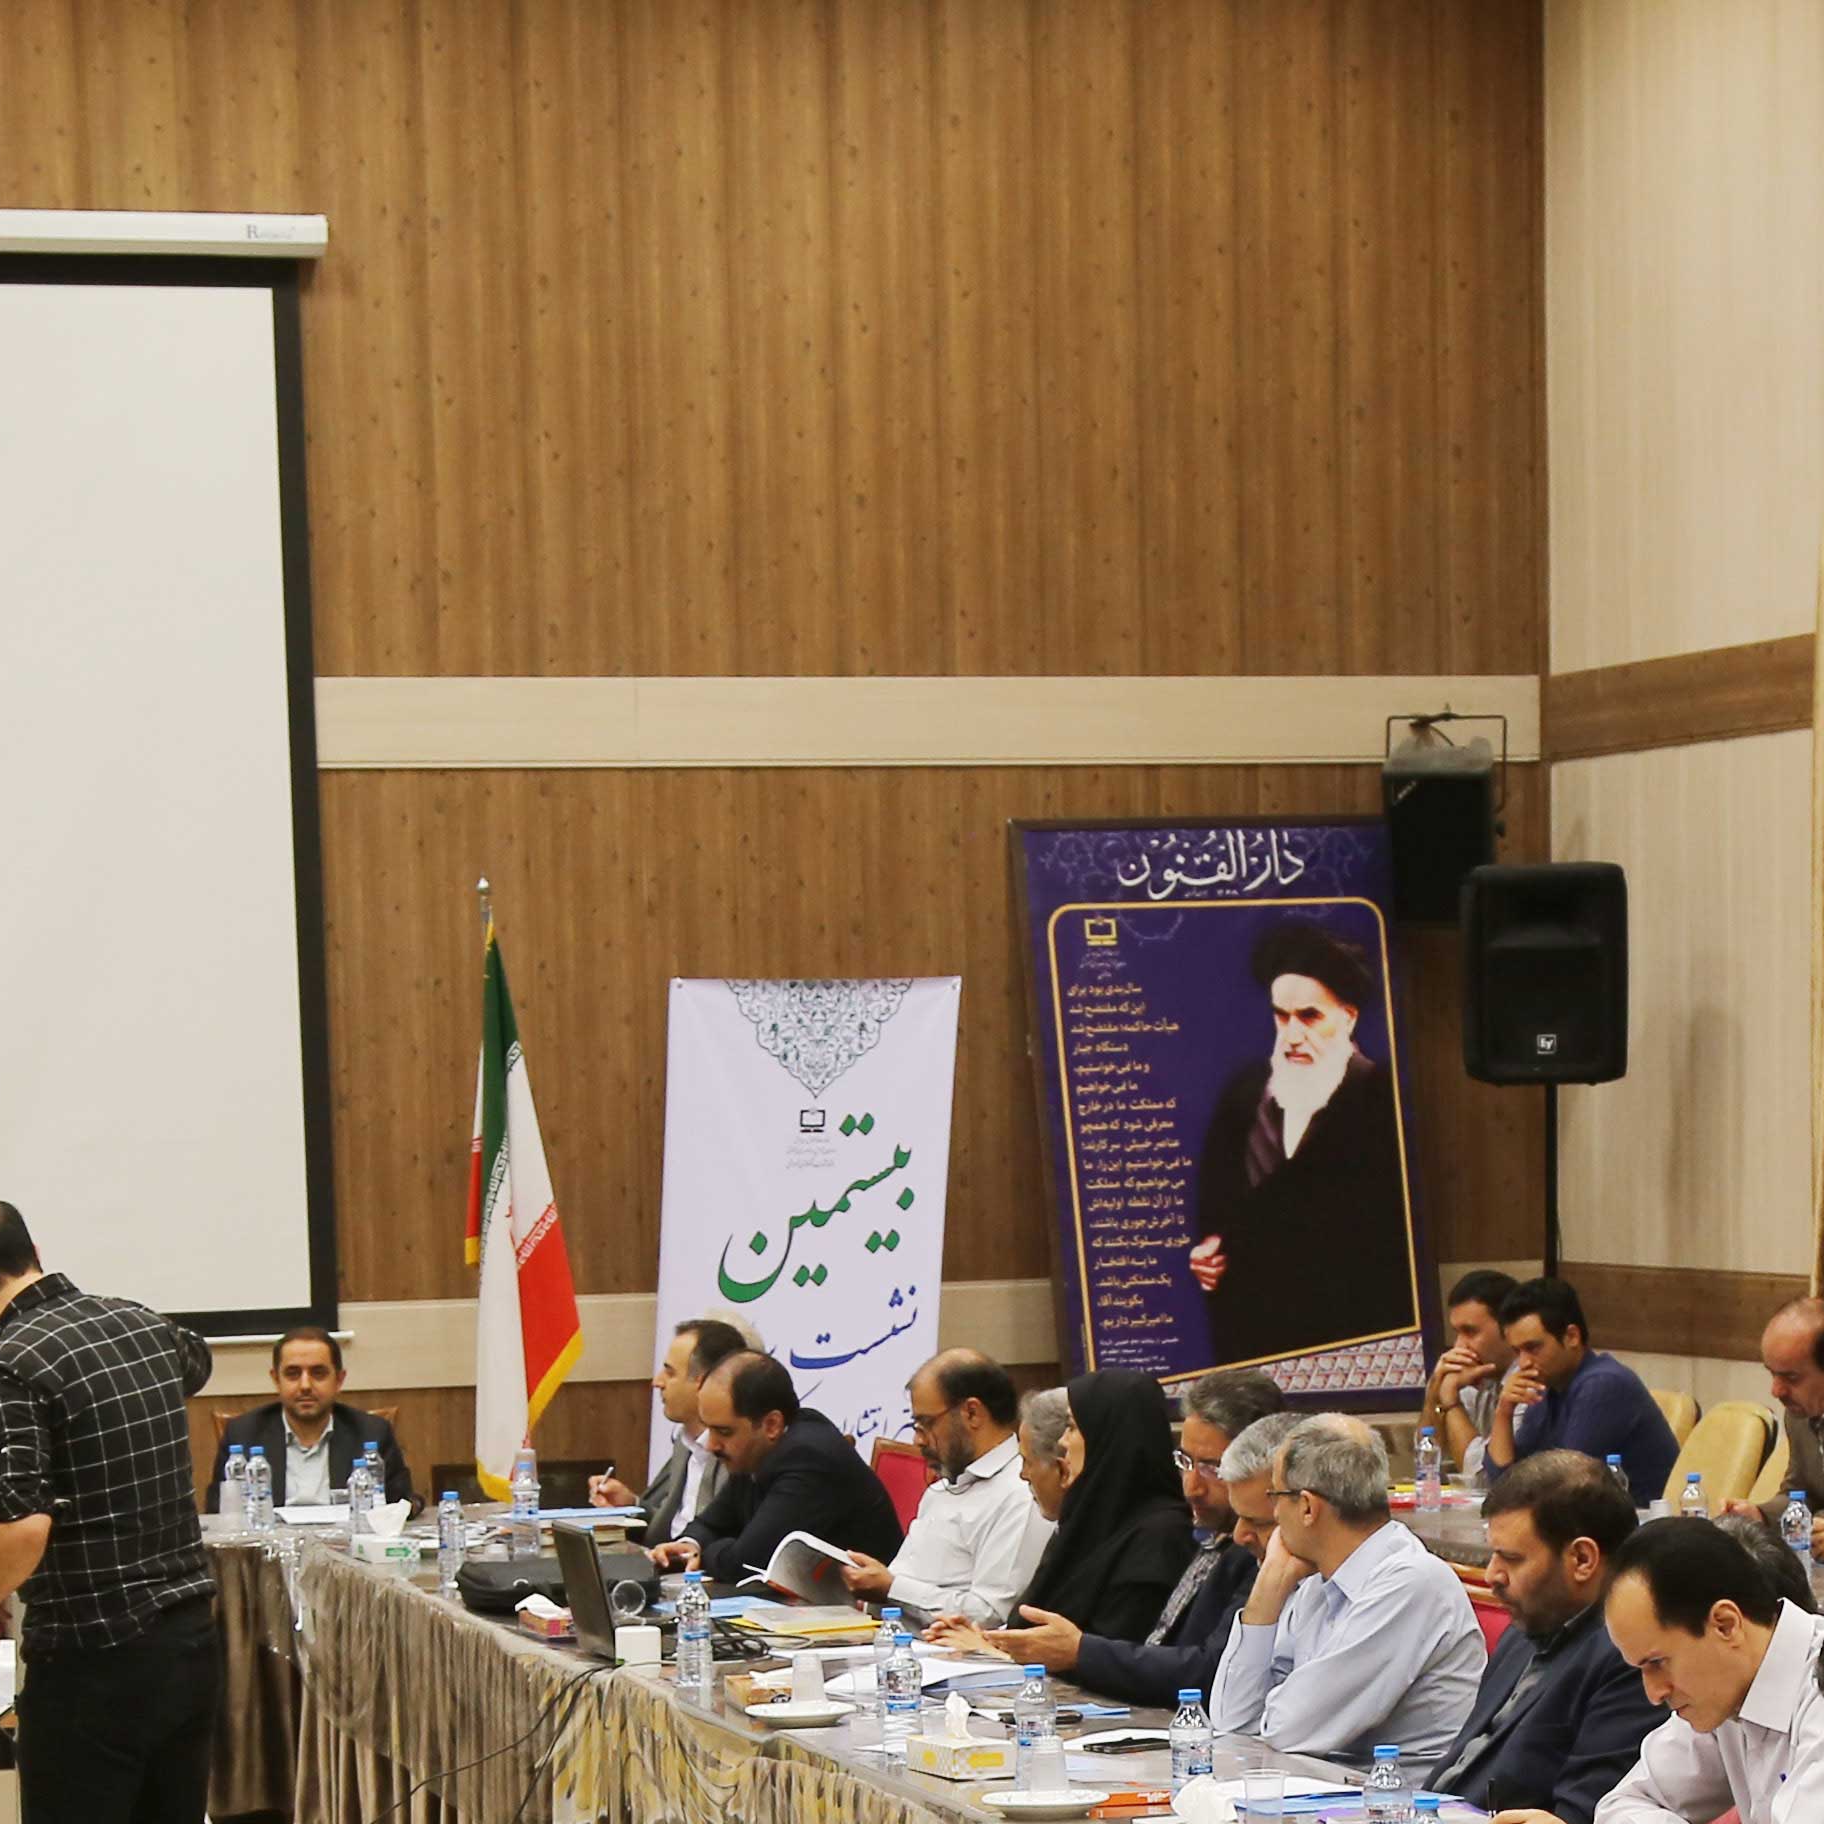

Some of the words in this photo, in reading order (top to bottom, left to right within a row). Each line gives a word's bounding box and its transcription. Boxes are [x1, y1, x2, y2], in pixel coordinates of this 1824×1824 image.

[1095, 1040, 1129, 1053] دستگاه
[1128, 1080, 1139, 1091] ما
[1078, 1101, 1101, 1117] خارج
[1116, 1100, 1128, 1111] ما
[1129, 1098, 1164, 1110] مملکت
[1165, 1097, 1177, 1110] که
[1080, 1121, 1109, 1135] همچو
[1109, 1118, 1121, 1130] که
[1123, 1119, 1143, 1133] شود
[1143, 1117, 1175, 1133] معرفی
[1153, 1138, 1181, 1152] عناصر
[1082, 1159, 1094, 1170] ما
[1182, 1156, 1193, 1166] ما
[1085, 1178, 1121, 1190] مملکت
[1174, 1194, 1185, 1206] ما
[718, 1113, 914, 1303] بیستمین
[1163, 1233, 1191, 1248] طوری
[789, 1285, 918, 1370] نشست
